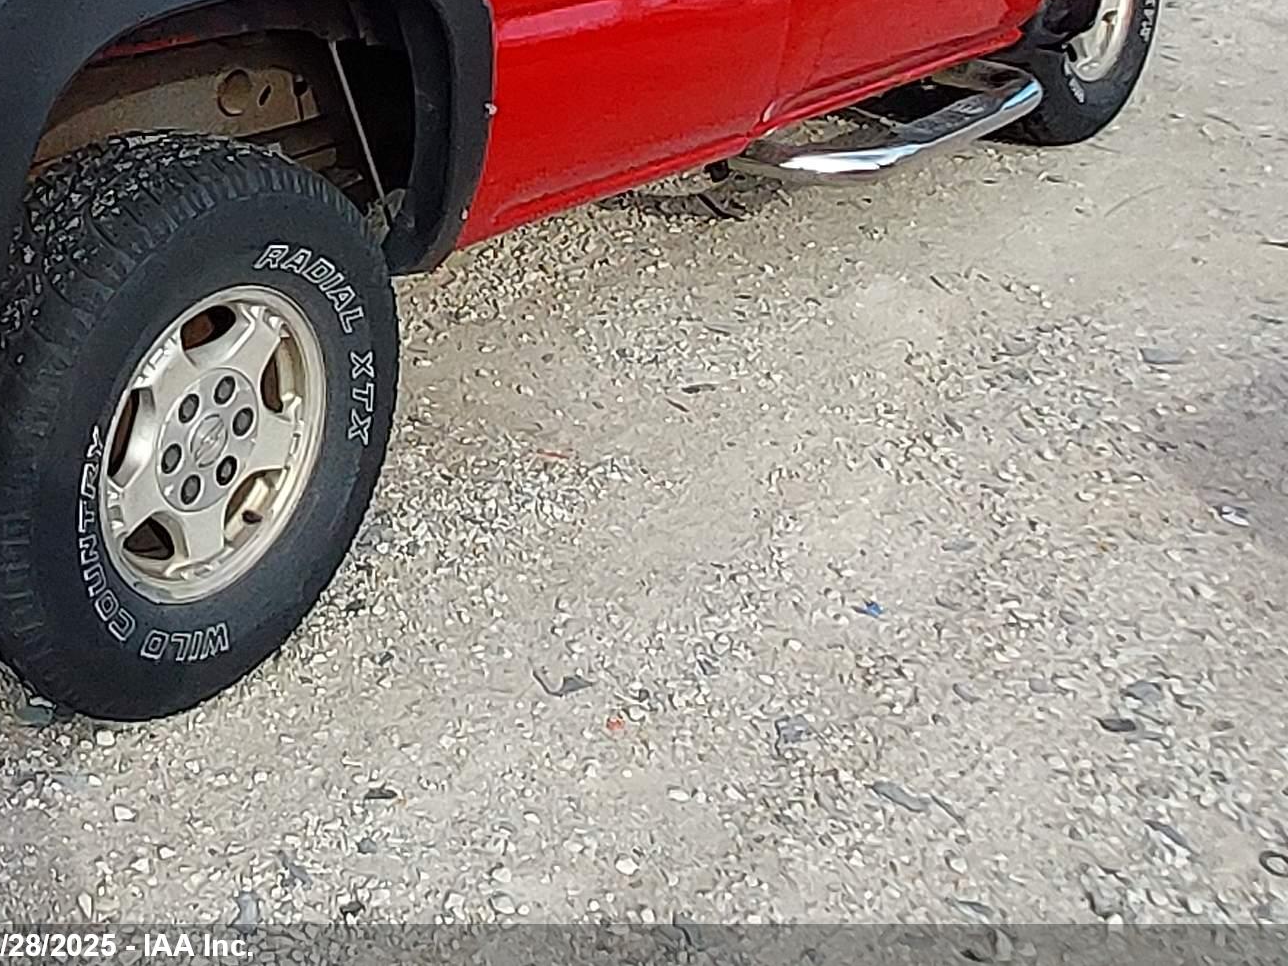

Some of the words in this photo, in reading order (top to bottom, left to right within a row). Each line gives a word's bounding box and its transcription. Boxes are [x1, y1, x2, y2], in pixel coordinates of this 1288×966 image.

[253, 244, 364, 334] RADIAL
[347, 350, 375, 446] XTX
[78, 425, 136, 642] COUNTRY
[140, 622, 230, 662] WILD
